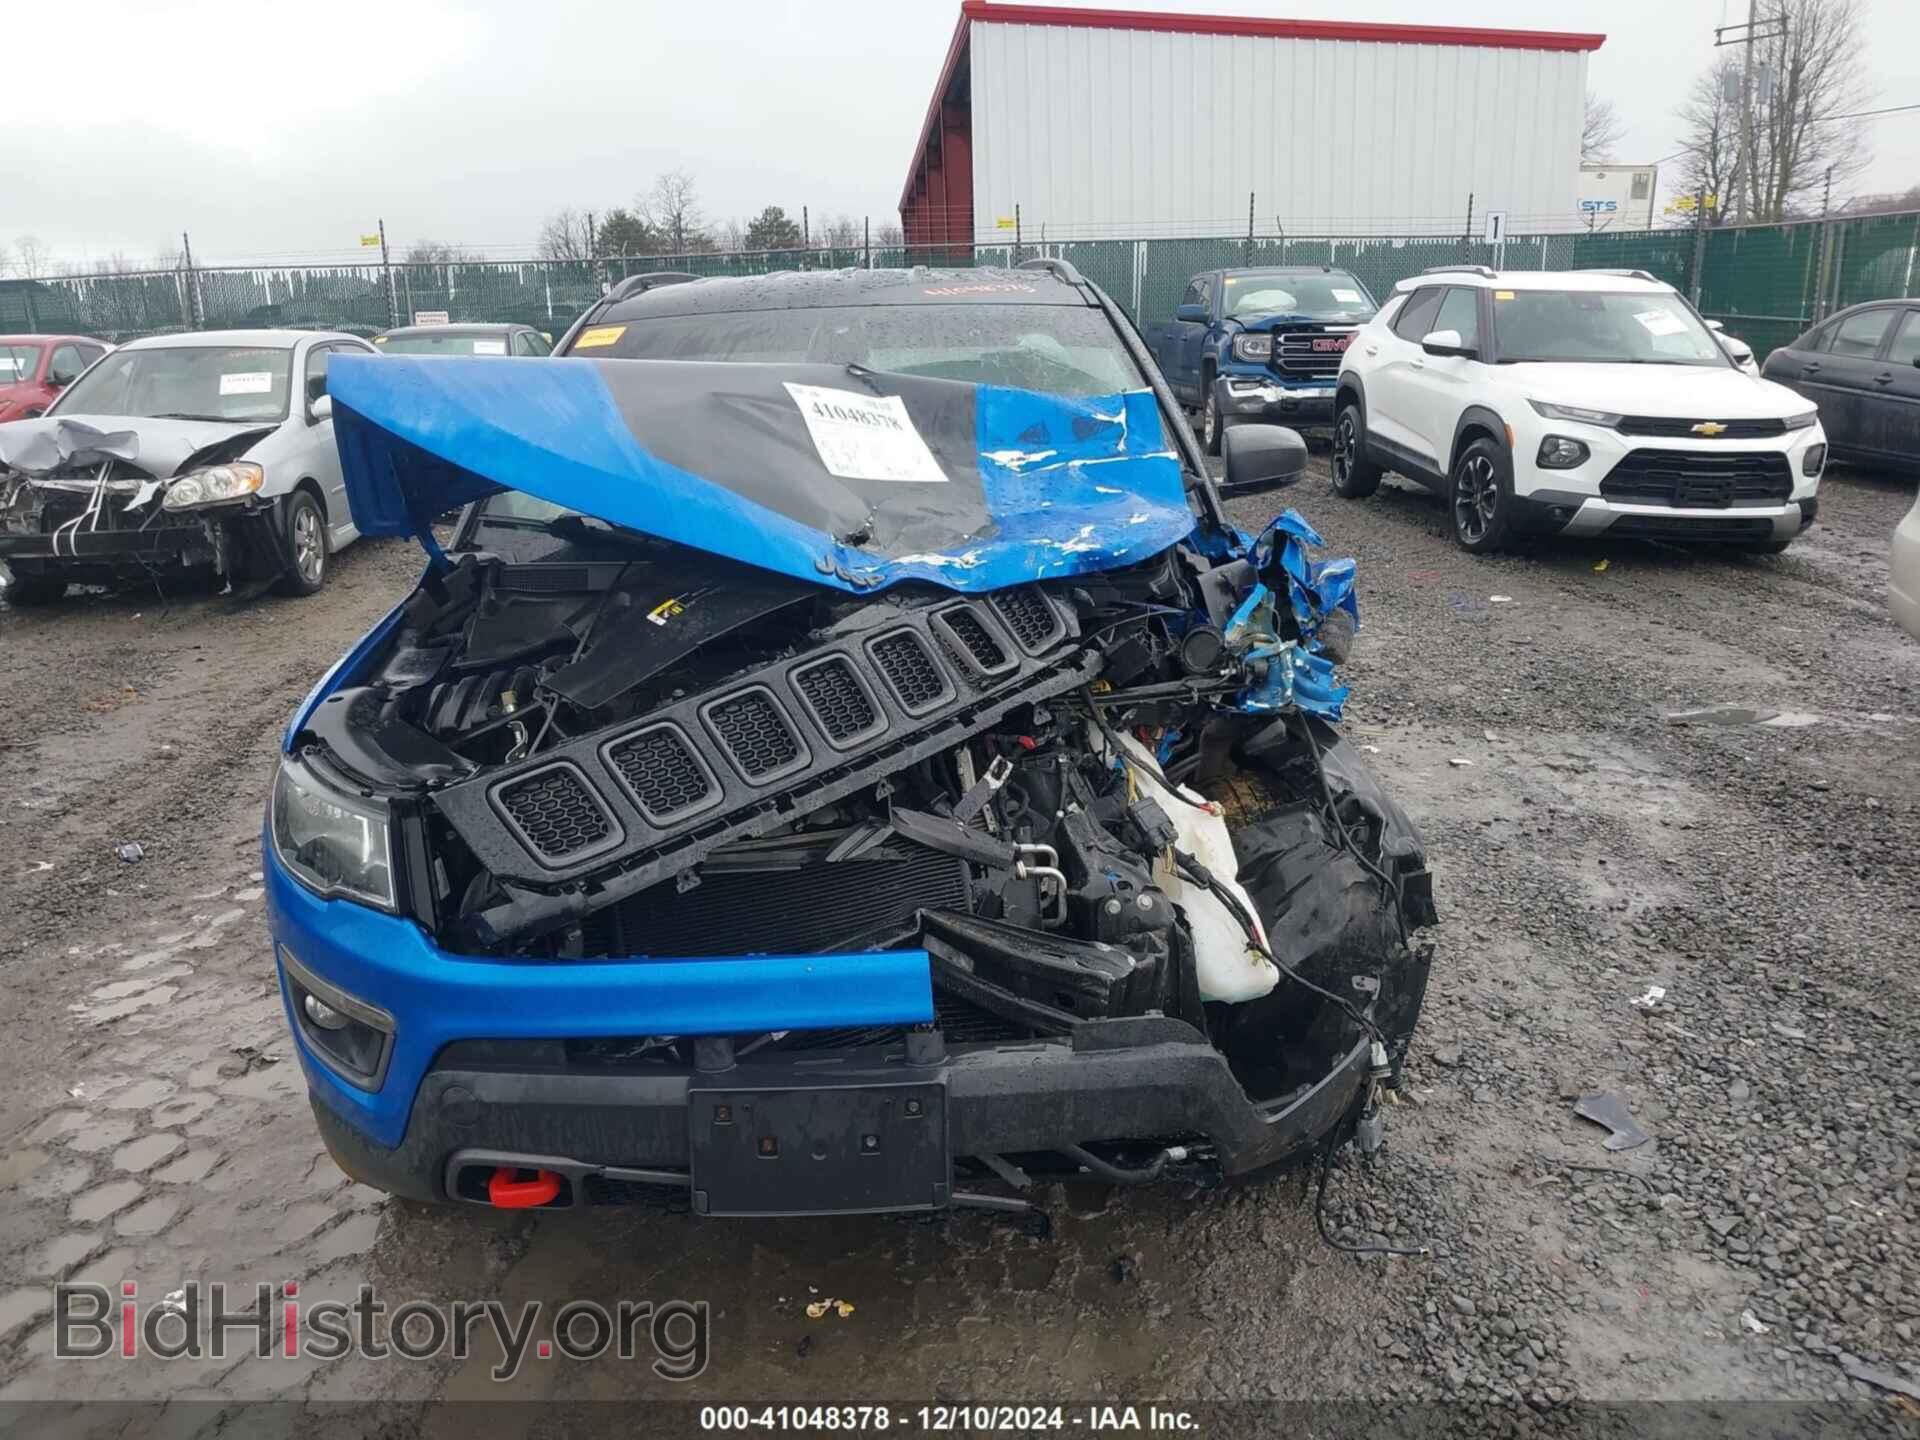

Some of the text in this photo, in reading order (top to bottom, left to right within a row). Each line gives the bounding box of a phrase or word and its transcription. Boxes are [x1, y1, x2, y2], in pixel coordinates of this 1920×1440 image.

[1582, 200, 1617, 212] STS
[1493, 215, 1499, 239] 1
[812, 401, 903, 431] 41048378
